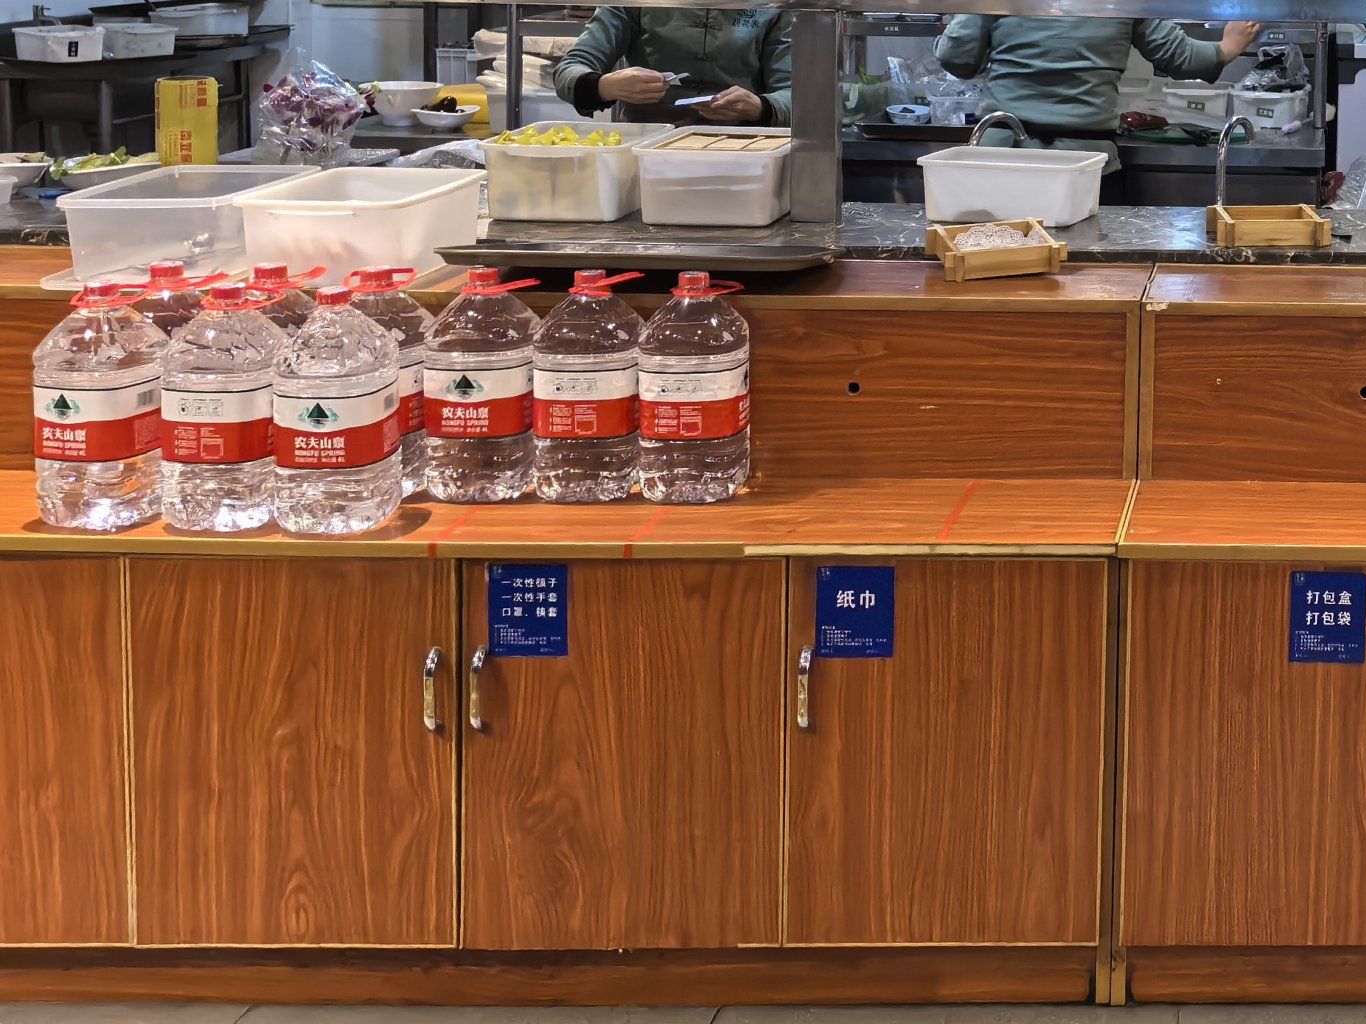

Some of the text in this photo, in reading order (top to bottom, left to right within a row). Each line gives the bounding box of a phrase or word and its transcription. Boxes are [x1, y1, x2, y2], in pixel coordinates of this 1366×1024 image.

[441, 407, 489, 419] 农夫山泉
[42, 426, 87, 441] 农夫山泉
[294, 436, 346, 449] 农夫山泉
[501, 592, 558, 603] 一次性手套
[836, 590, 876, 609] 纸巾
[1306, 590, 1352, 605] 打包盒
[1305, 610, 1351, 626] 打包袋
